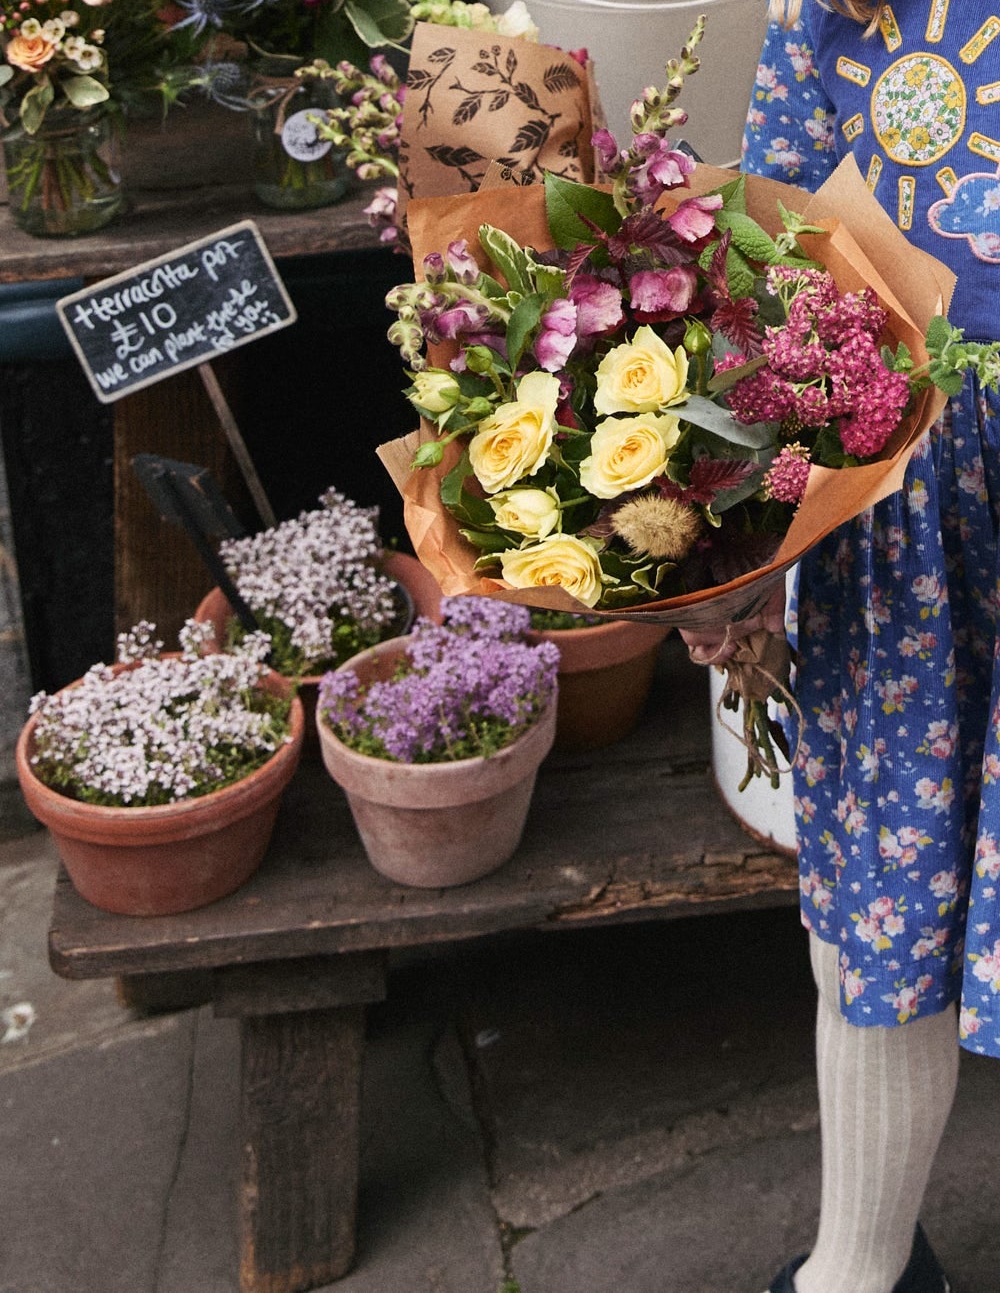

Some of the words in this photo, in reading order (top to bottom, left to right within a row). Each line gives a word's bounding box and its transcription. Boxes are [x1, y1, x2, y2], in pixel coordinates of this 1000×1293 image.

[202, 240, 246, 282] pot
[110, 302, 177, 359] £10
[129, 347, 164, 373] can
[164, 322, 207, 363] plant
[206, 279, 258, 331] these
[234, 300, 269, 333] you
